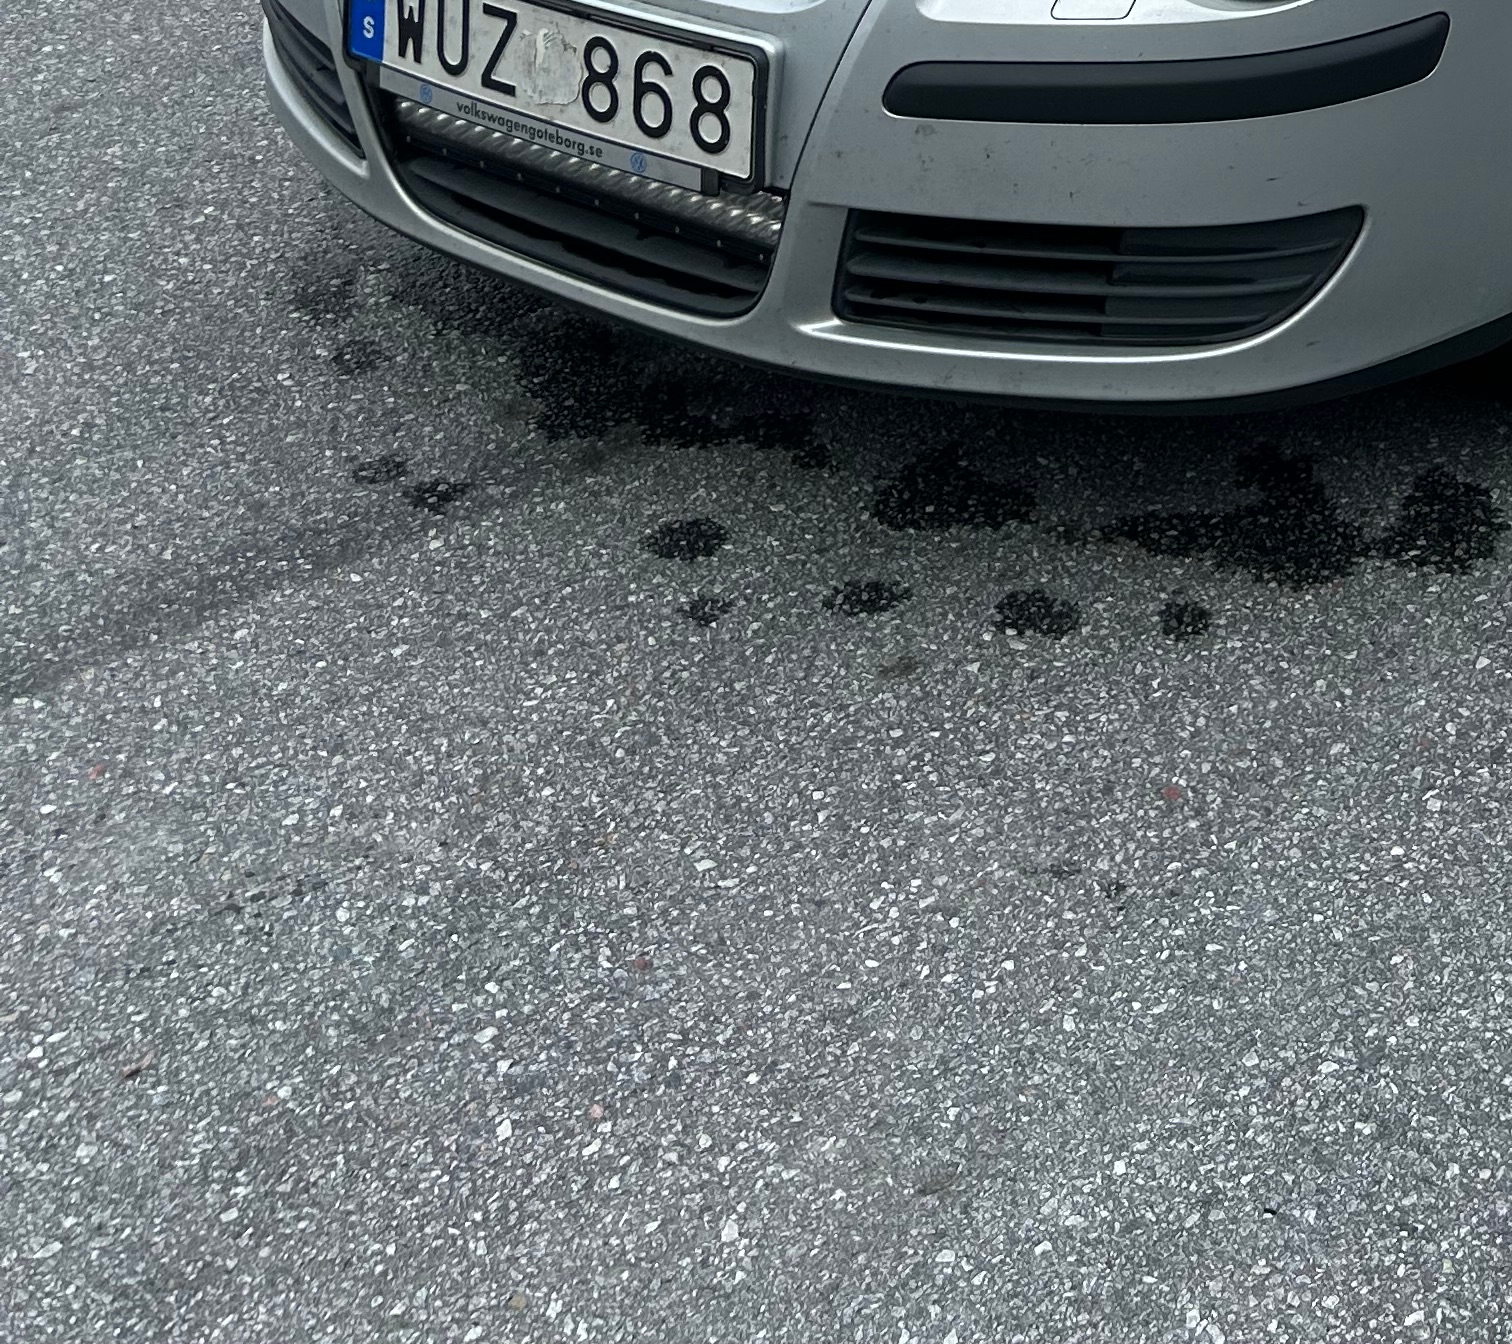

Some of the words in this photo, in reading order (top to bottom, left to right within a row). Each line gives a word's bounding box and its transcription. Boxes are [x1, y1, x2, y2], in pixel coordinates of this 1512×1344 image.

[363, 15, 375, 39] S
[581, 35, 732, 154] 868
[456, 101, 604, 158] volkswagengoteborg.se
